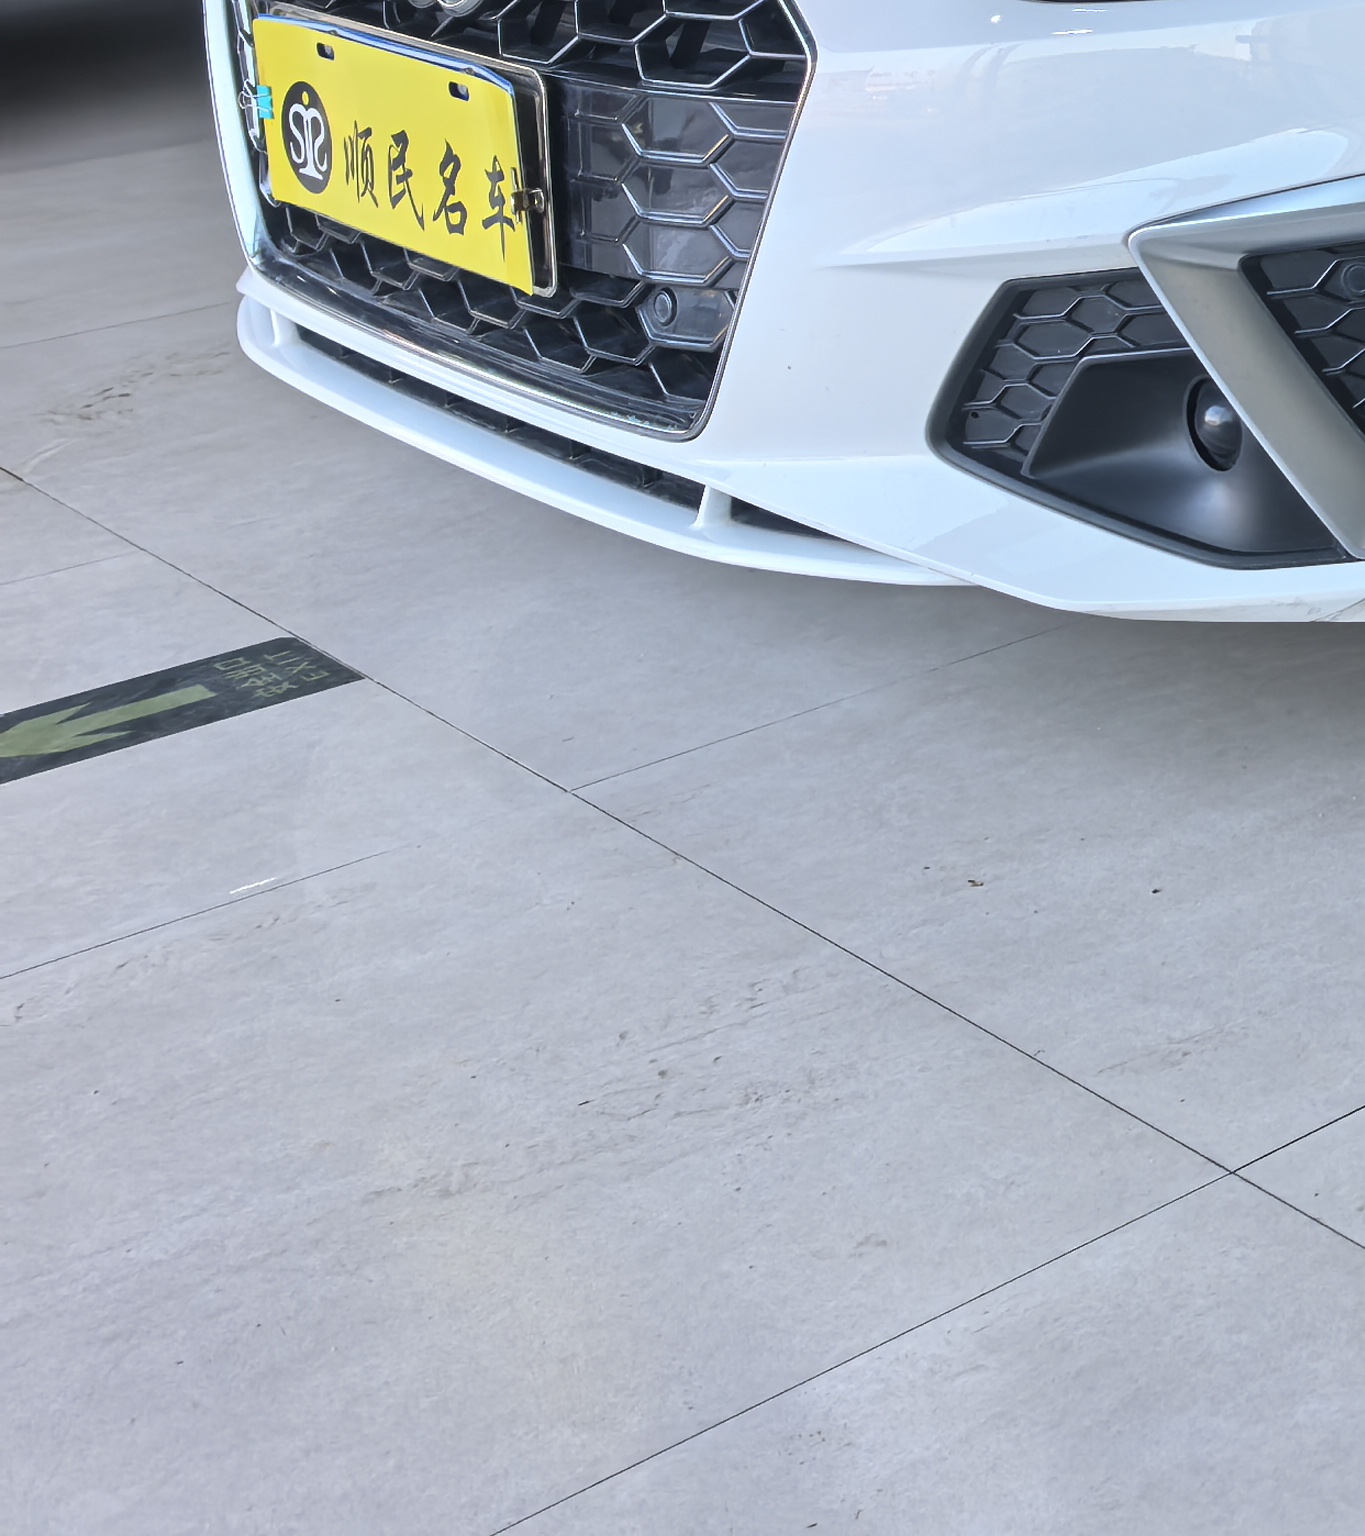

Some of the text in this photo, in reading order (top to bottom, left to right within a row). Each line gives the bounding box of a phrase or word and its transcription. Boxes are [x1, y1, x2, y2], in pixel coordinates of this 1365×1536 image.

[343, 119, 518, 263] 顺民名车
[263, 650, 331, 682] EXIT
